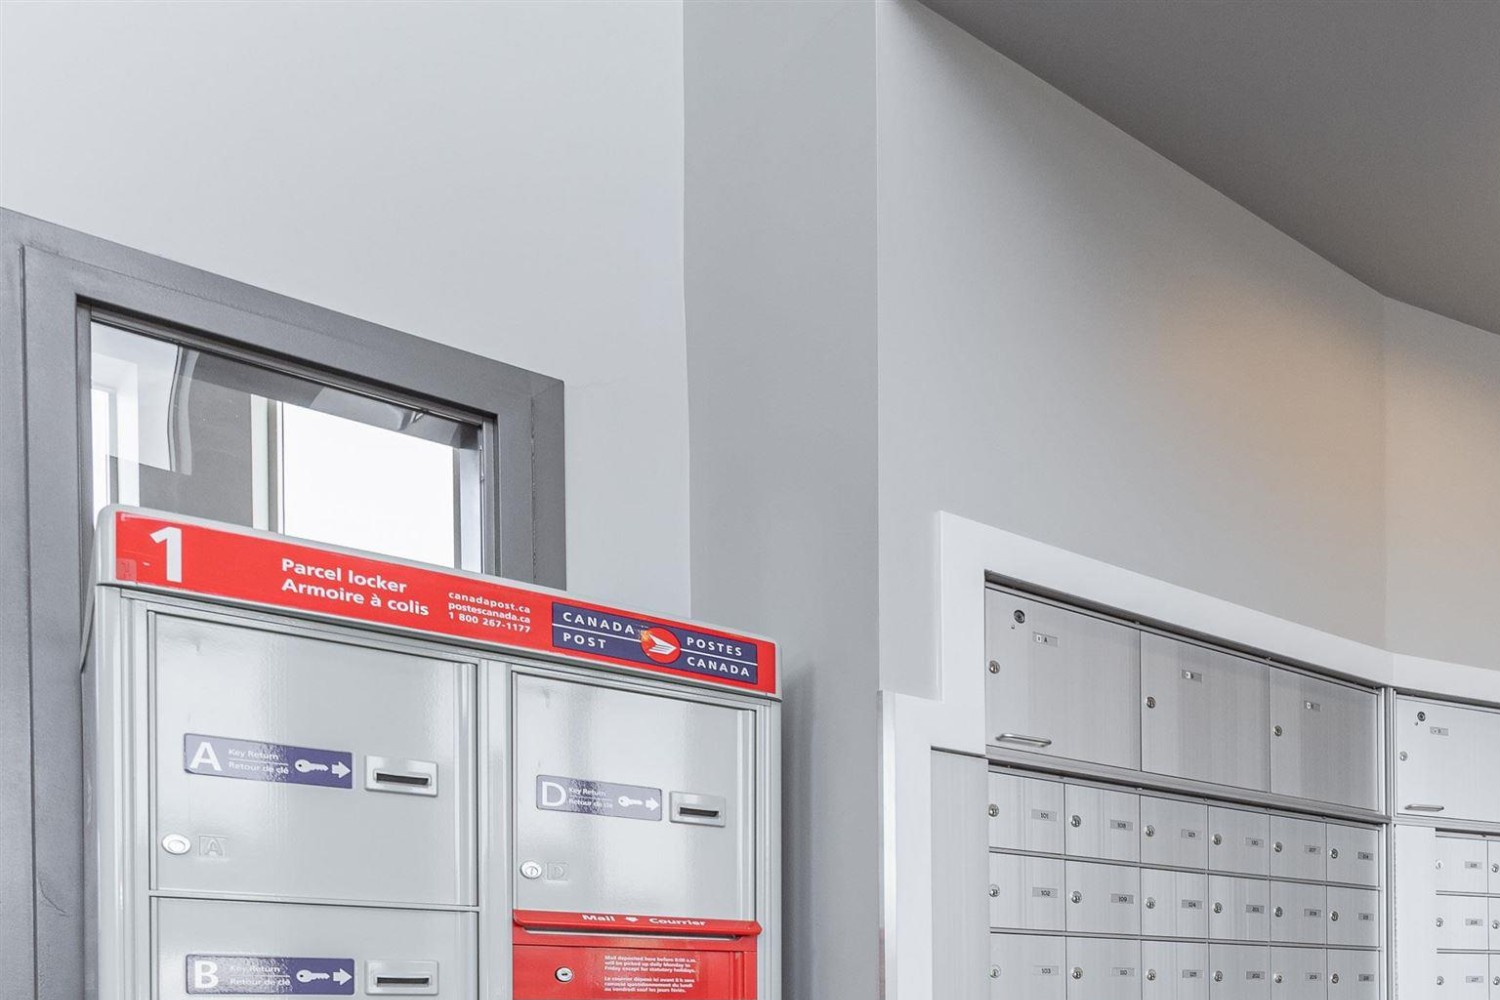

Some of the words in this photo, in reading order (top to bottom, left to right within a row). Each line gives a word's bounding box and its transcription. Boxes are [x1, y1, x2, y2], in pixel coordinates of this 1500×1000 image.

[150, 526, 182, 583] 1
[281, 557, 342, 582] Parcel
[348, 567, 407, 593] locker
[281, 578, 364, 604] Armoire
[371, 593, 381, 608] à
[387, 597, 430, 616] colis
[448, 591, 531, 614] canadapost.ca
[448, 602, 531, 625] postescanada.ca
[449, 612, 454, 621] 1
[458, 613, 479, 625] 800
[482, 617, 531, 634] 267-1177
[563, 612, 635, 635] CANADA
[563, 632, 607, 650] POST
[687, 637, 743, 657] POSTES
[687, 657, 751, 678] CANADA
[189, 742, 223, 772] A
[228, 761, 261, 772] Retour
[248, 750, 279, 760] Return
[542, 781, 567, 807] D
[582, 913, 616, 923] Mail
[649, 917, 707, 927] Courrier
[194, 960, 219, 989] B
